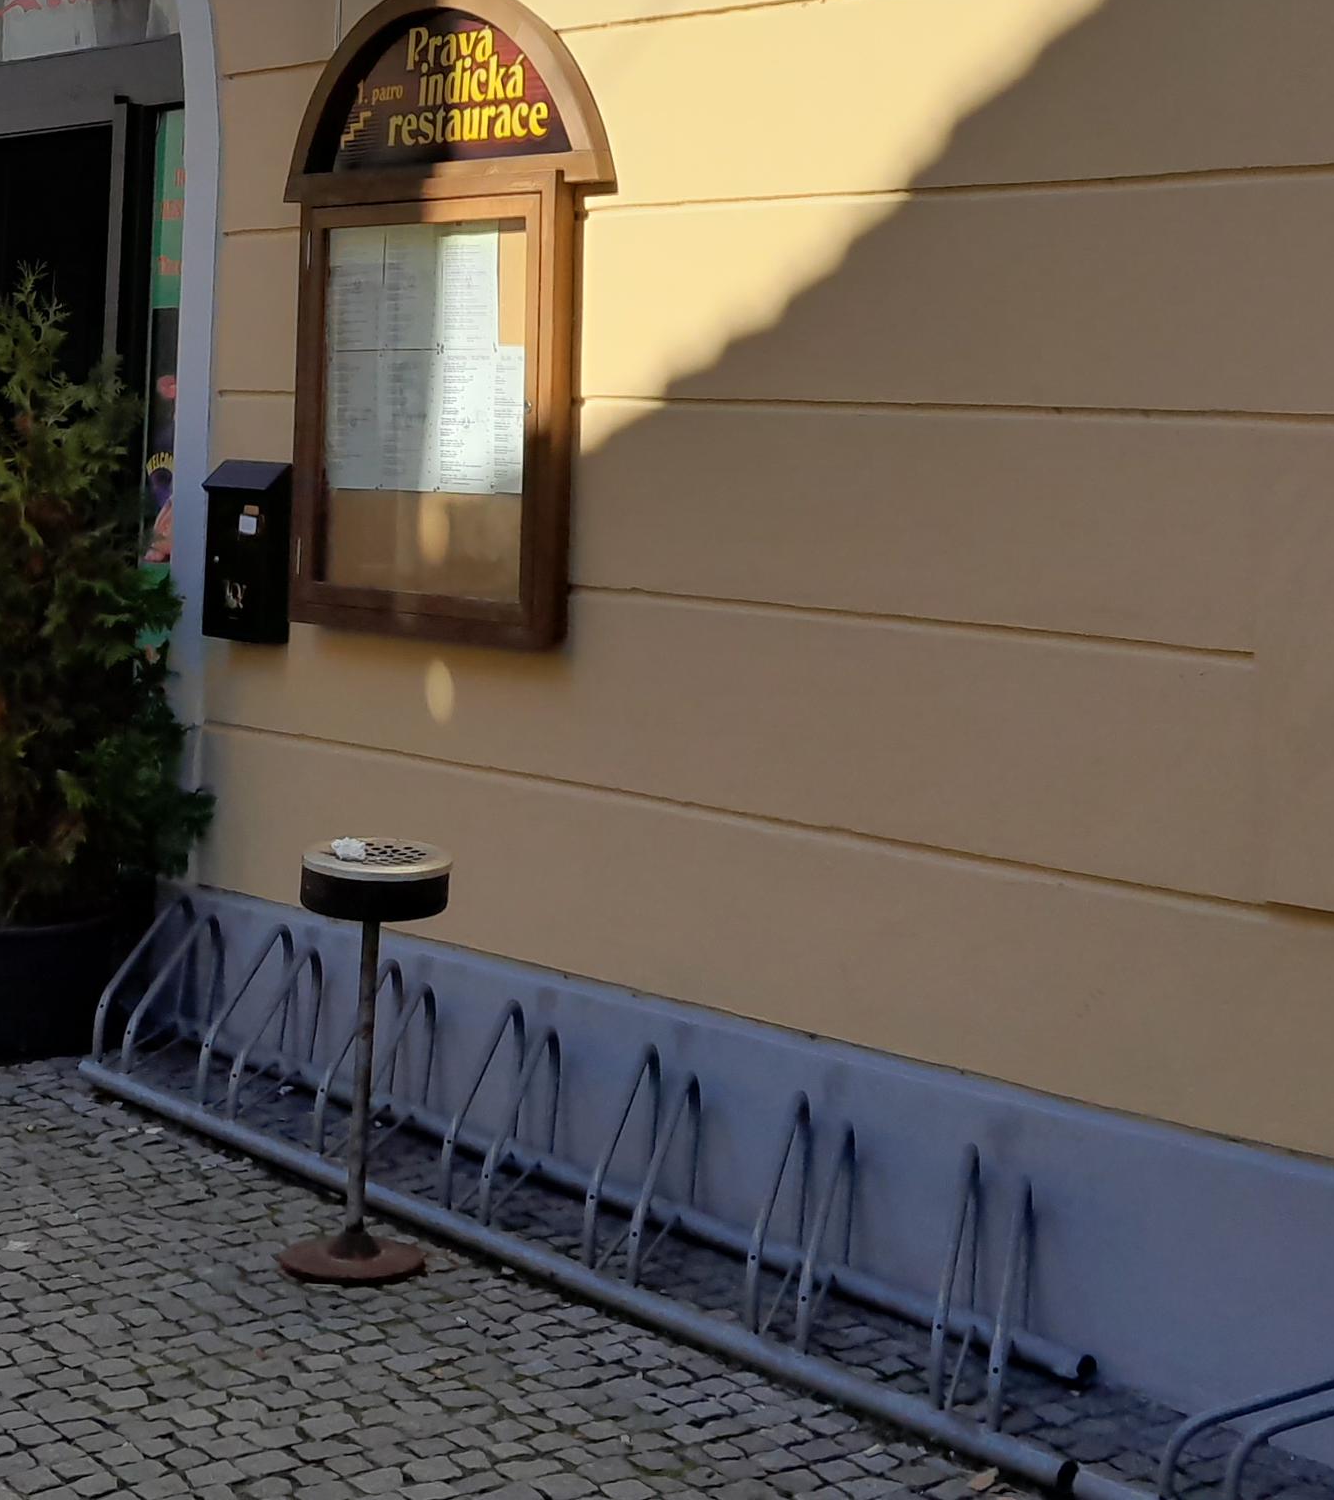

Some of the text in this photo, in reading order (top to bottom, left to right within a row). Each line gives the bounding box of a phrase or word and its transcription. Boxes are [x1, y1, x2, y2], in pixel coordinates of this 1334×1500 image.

[405, 25, 494, 72] Pravá
[417, 53, 526, 108] indická
[387, 100, 550, 148] restaurace
